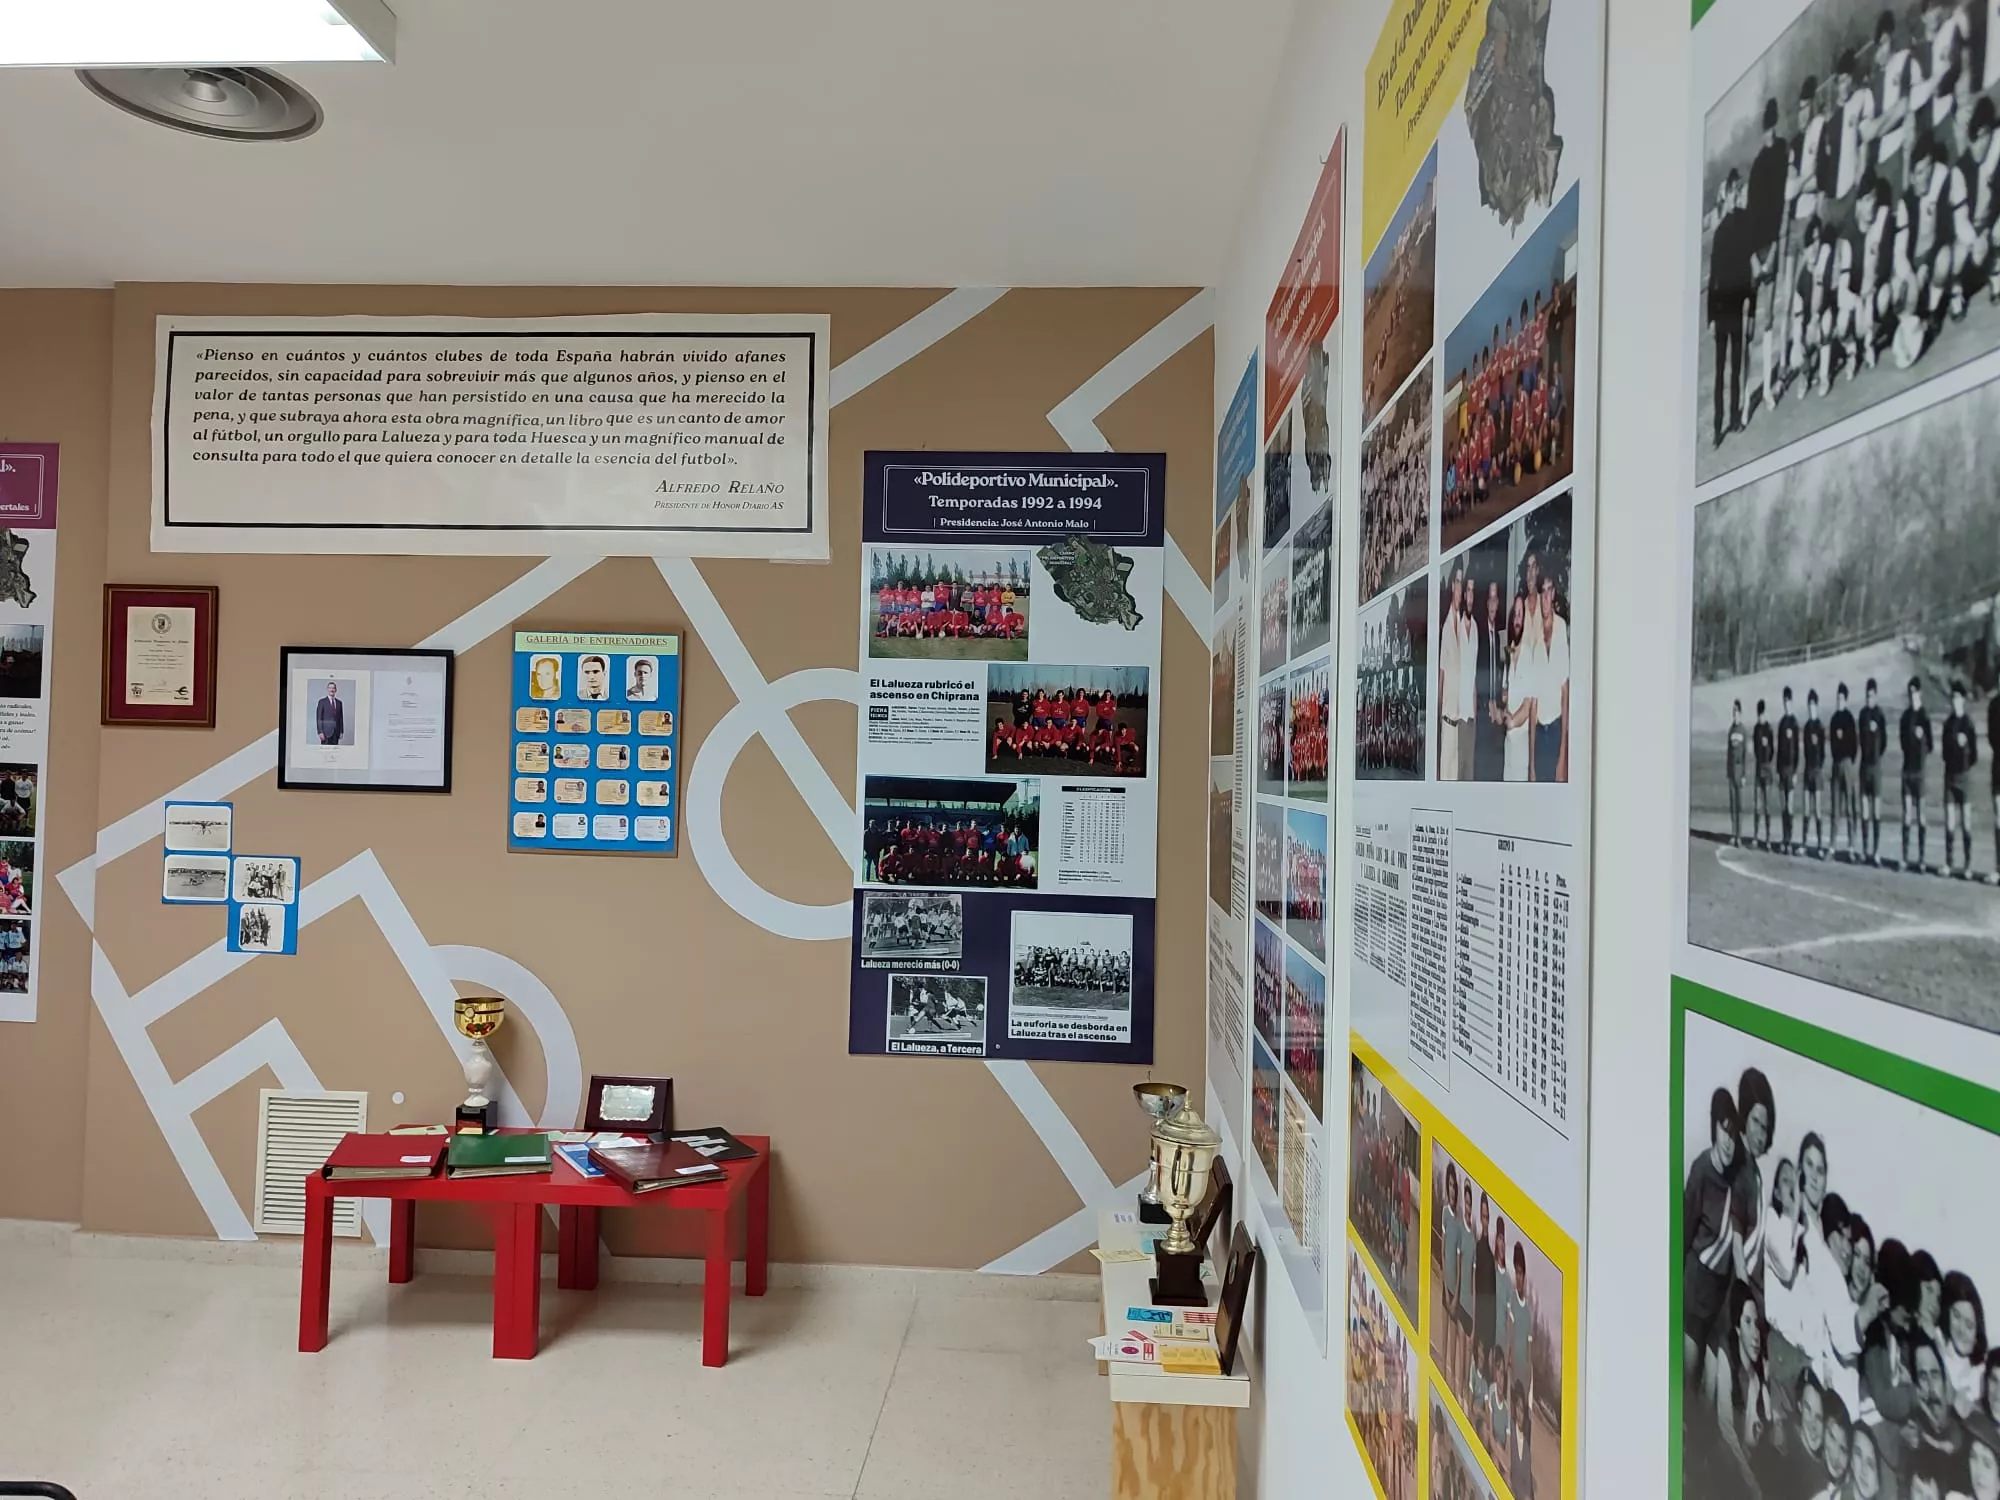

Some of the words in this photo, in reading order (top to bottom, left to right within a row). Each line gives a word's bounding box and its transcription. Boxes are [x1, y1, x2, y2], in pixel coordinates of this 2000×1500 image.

[196, 348, 253, 360] «Pienso
[261, 352, 278, 360] en
[286, 349, 345, 361] cuántos
[351, 352, 360, 364] y
[367, 349, 427, 361] cuántos
[435, 349, 482, 361] clubes
[490, 349, 507, 361] de
[515, 349, 548, 362] toda
[556, 349, 612, 365] España
[619, 349, 674, 362] habrán
[682, 350, 727, 362] vivido
[734, 350, 786, 364] afanes
[194, 368, 272, 383] parecidos,
[277, 369, 299, 381] sin
[304, 369, 382, 384] capacidad
[386, 372, 421, 384] para
[426, 369, 500, 382] sobrevivir
[504, 370, 536, 382] más
[540, 373, 568, 385] que
[573, 370, 632, 385] algunos
[637, 371, 677, 384] años,
[681, 373, 690, 386] y
[695, 370, 744, 385] pienso
[749, 373, 767, 382] en
[772, 370, 785, 383] el
[194, 388, 234, 400] valor
[238, 389, 256, 401] de
[262, 391, 309, 401] tantas
[313, 392, 381, 404] personas
[386, 393, 412, 404] que
[418, 390, 447, 402] han
[452, 390, 526, 405] persistido
[531, 393, 549, 402] en
[554, 394, 583, 402] una
[588, 394, 633, 403] causa
[638, 394, 666, 406] que
[671, 391, 690, 403] ha
[695, 391, 765, 403] merecido
[771, 391, 784, 403] la
[193, 411, 234, 423] pena,
[236, 412, 246, 424] y
[249, 412, 276, 424] que
[279, 409, 339, 425] subraya
[342, 411, 386, 423] ahora
[391, 413, 421, 423] esta
[425, 411, 459, 424] obra
[462, 413, 543, 428] magnífica,
[546, 416, 564, 425] un
[568, 413, 602, 426] libro
[606, 414, 633, 426] que
[637, 415, 652, 424] es
[656, 415, 675, 424] un
[678, 413, 720, 423] canto
[723, 411, 741, 423] de
[744, 415, 785, 424] amor
[192, 428, 208, 440] al
[211, 428, 260, 443] fútbol,
[264, 432, 283, 441] un
[287, 430, 340, 445] orgullo
[342, 433, 377, 445] para
[381, 430, 440, 442] Lalueza
[442, 434, 452, 446] y
[454, 434, 489, 445] para
[493, 431, 526, 443] toda
[530, 431, 586, 443] Huesca
[588, 434, 598, 446] y
[602, 435, 620, 443] un
[624, 431, 700, 446] magnífico
[704, 432, 763, 444] manual
[766, 432, 784, 445] de
[192, 449, 258, 461] consulta
[262, 453, 296, 464] para
[301, 450, 334, 462] todo
[337, 450, 350, 462] el
[354, 453, 380, 465] que
[384, 450, 432, 465] quiera
[436, 454, 496, 463] conocer
[499, 454, 516, 463] en
[520, 451, 572, 463] detalle
[576, 451, 589, 463] la
[594, 452, 650, 464] esencia
[654, 452, 677, 464] del
[680, 452, 737, 466] futbol».
[655, 479, 720, 493] ALFREDO
[727, 480, 784, 493] RELAÑO
[914, 472, 1026, 489] «Polideportivo
[1028, 474, 1118, 490] Municipal».
[928, 496, 1018, 510] Temporadas
[1021, 497, 1054, 508] 1992
[1056, 500, 1067, 508] a
[1069, 497, 1102, 509] 1994
[940, 517, 999, 527] Presidencia:
[1000, 518, 1022, 527] José
[1024, 518, 1064, 528] Antonio
[1065, 519, 1089, 528] Malo
[526, 634, 570, 645] GALERÍA
[573, 636, 585, 645] DE
[590, 637, 668, 647] ENTRENADORES
[870, 679, 880, 688] El
[882, 679, 923, 689] Lalueza
[924, 680, 963, 690] rubricó
[965, 681, 975, 690] el
[870, 691, 914, 700] ascenso
[931, 692, 980, 702] Chiprana
[860, 959, 890, 968] Lalueza
[891, 959, 923, 969] mereció
[923, 959, 941, 969] más
[941, 959, 959, 971] (0-0)
[1011, 1019, 1022, 1028] La
[1023, 1019, 1057, 1028] euforia
[1070, 1021, 1114, 1031] desborda
[1011, 1029, 1046, 1039] Lalueza
[1047, 1030, 1066, 1038] tras
[1067, 1031, 1076, 1039] el
[891, 1042, 900, 1052] El
[901, 1042, 939, 1053] Lalueza,
[940, 1045, 946, 1053] a
[947, 1043, 982, 1055] Tercera
